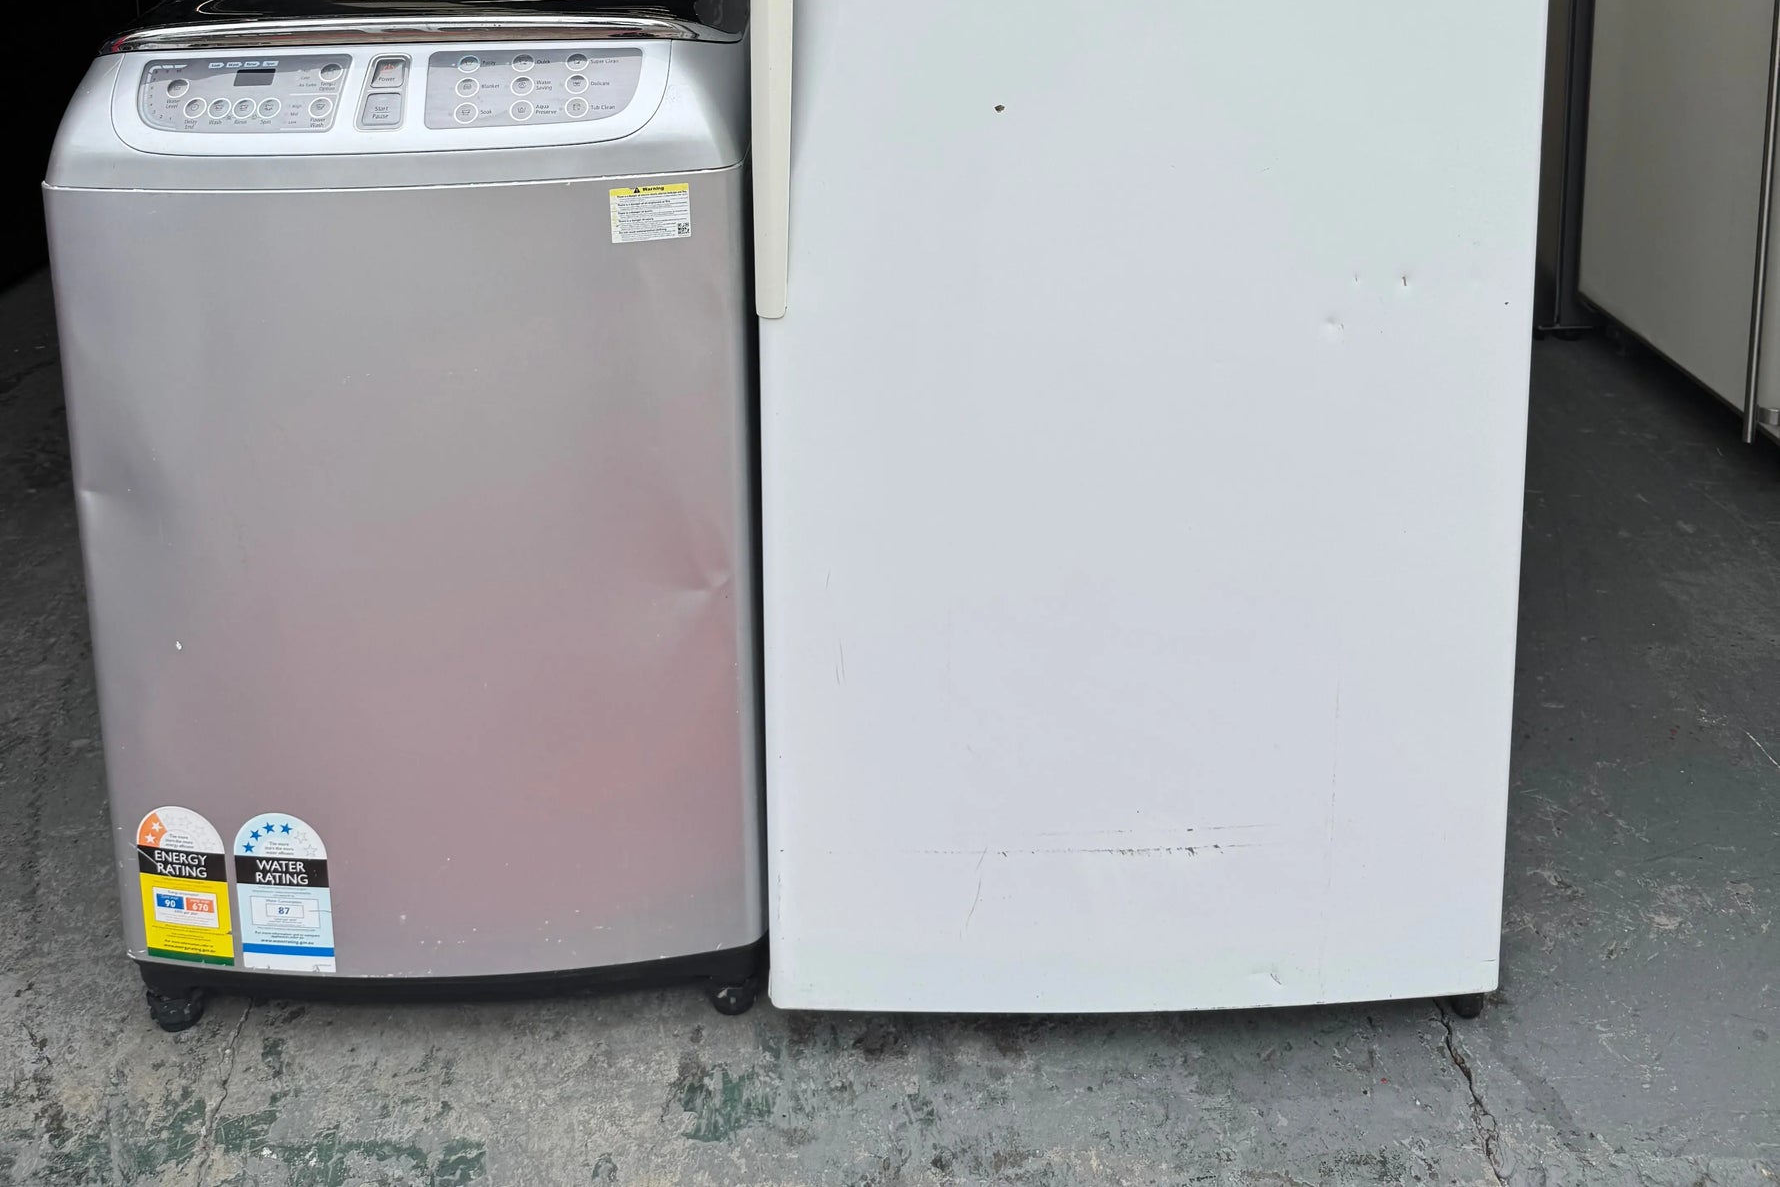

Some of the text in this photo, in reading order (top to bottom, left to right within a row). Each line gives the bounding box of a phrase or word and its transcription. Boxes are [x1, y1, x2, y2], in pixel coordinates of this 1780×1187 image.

[155, 850, 208, 866] ENERGY
[157, 862, 208, 878] RATING
[256, 859, 306, 873] WATER
[255, 872, 309, 885] RATING
[164, 899, 176, 908] 90
[192, 903, 209, 912] 670
[278, 906, 290, 915] 87
